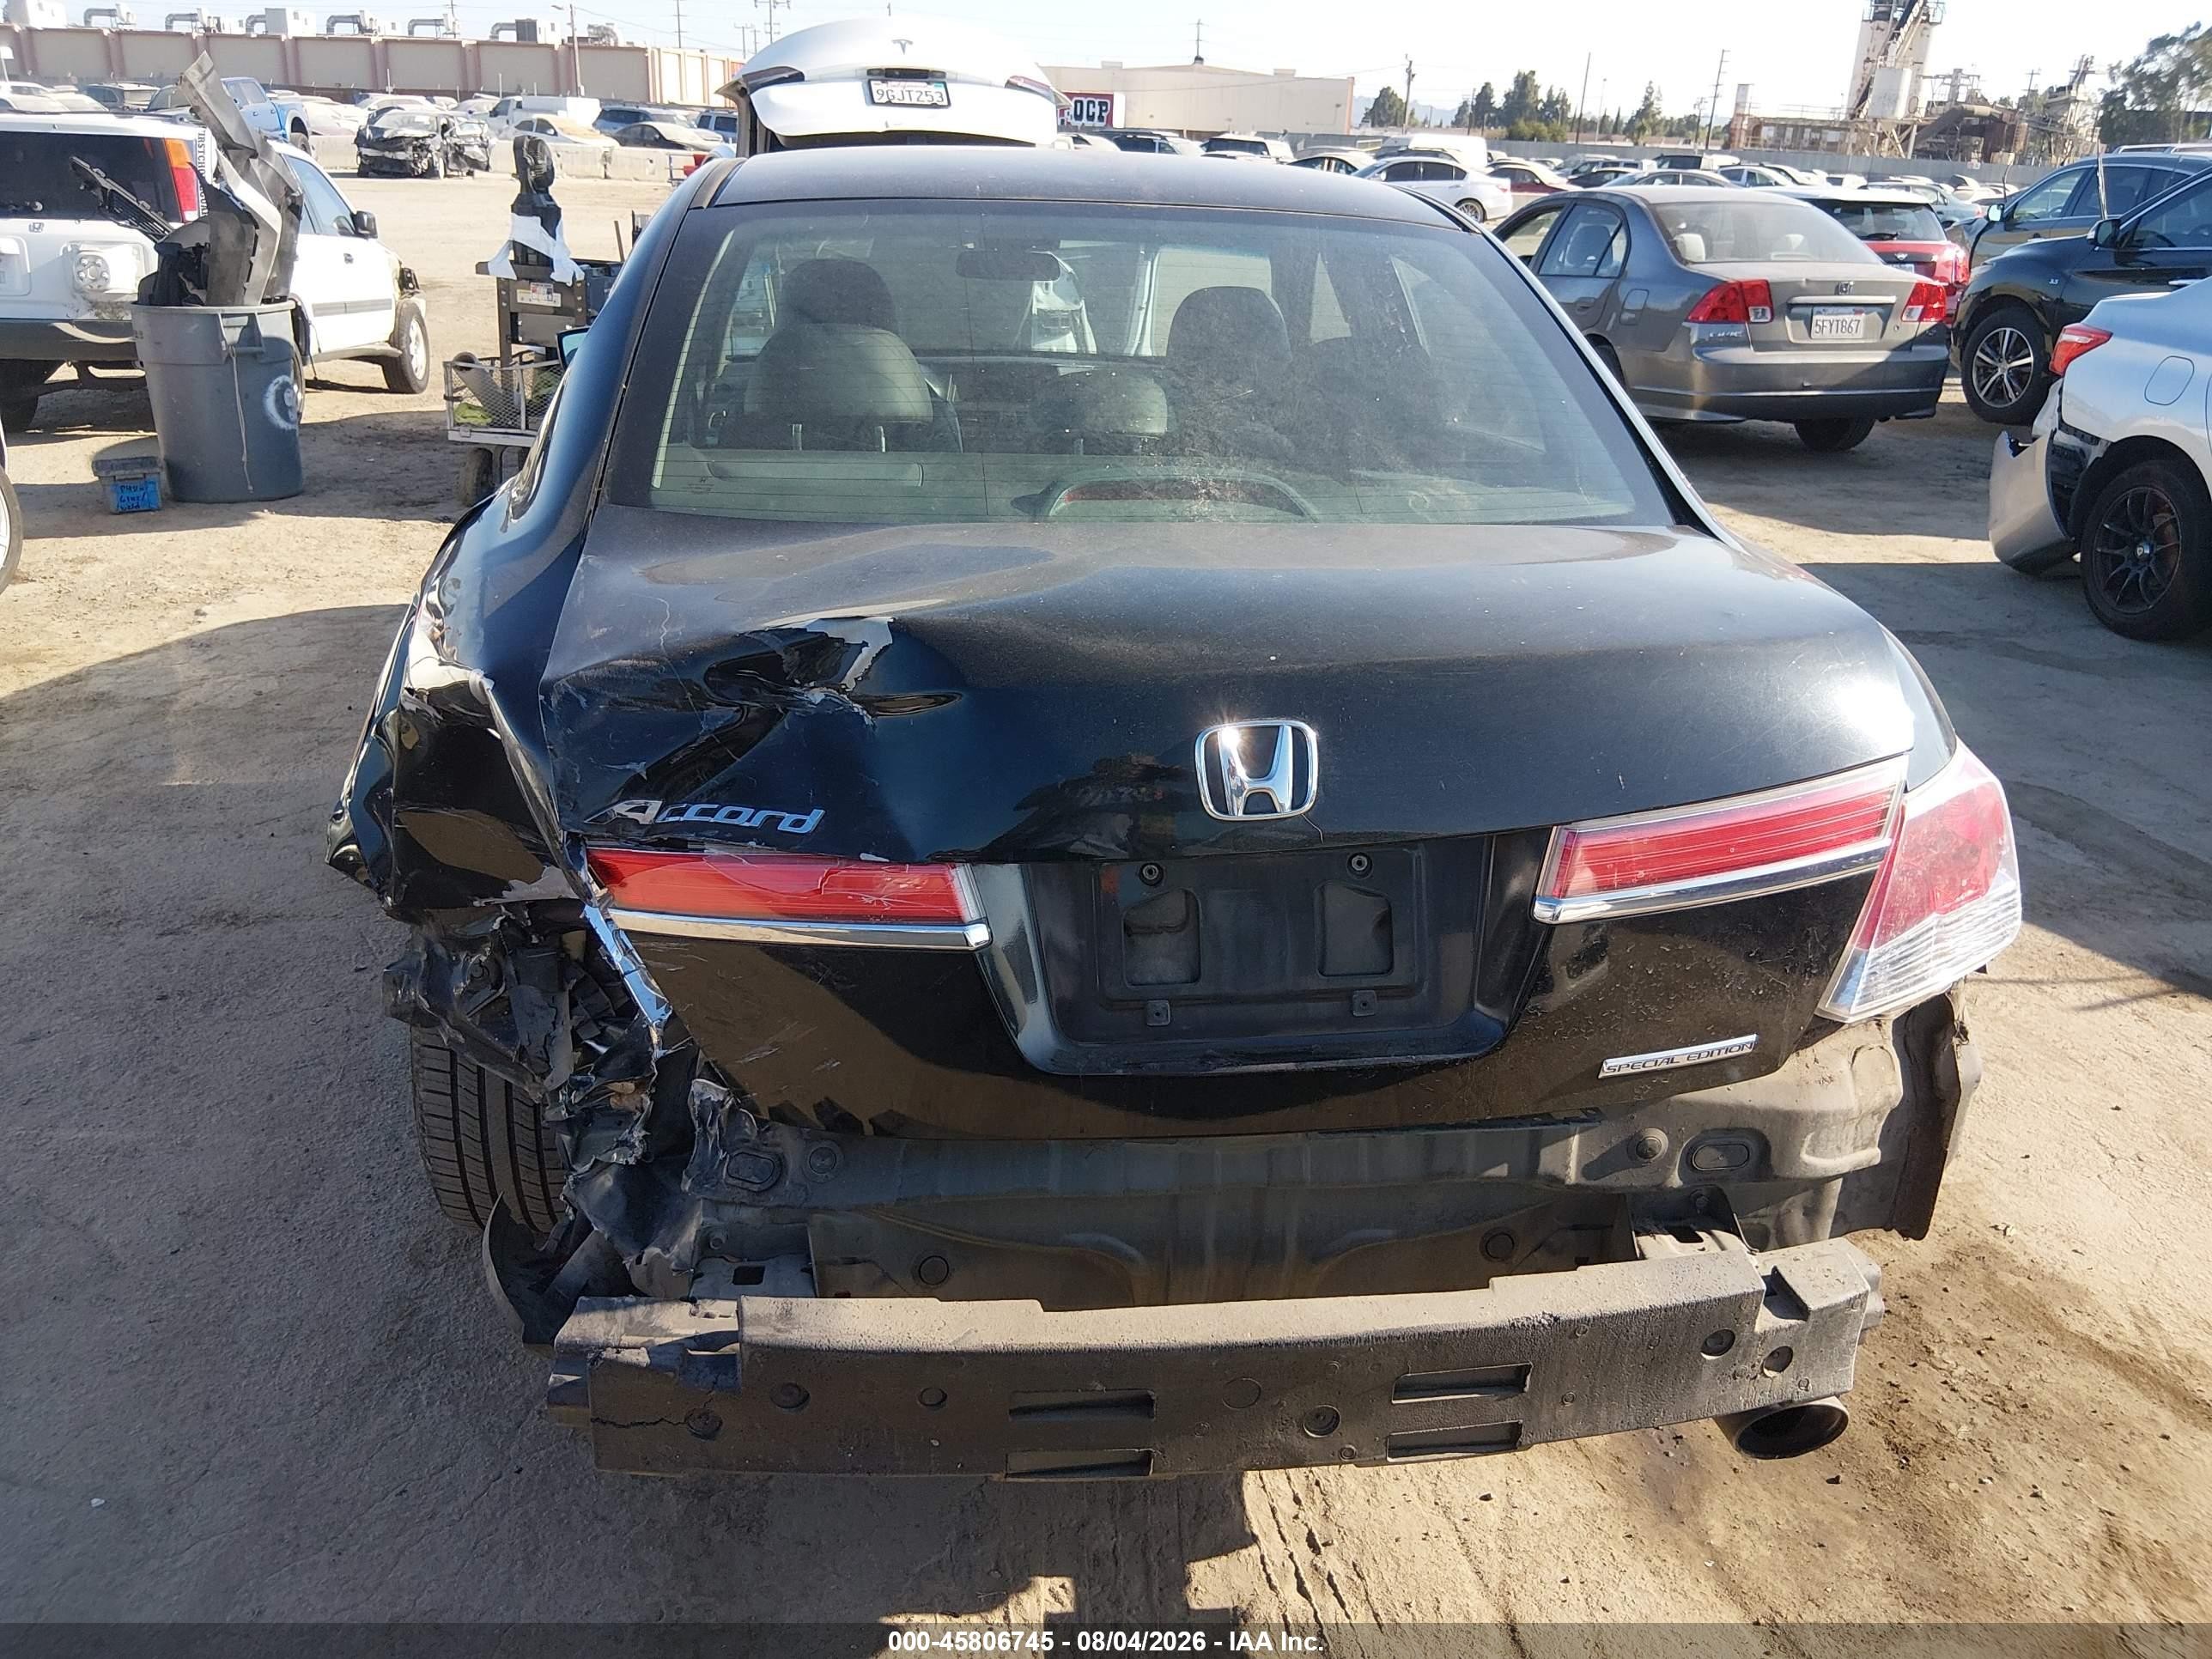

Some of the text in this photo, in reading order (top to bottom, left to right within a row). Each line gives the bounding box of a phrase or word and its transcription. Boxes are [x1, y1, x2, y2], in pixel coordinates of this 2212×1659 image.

[876, 88, 944, 102] 9GJT253
[1067, 99, 1109, 124] OCP
[1814, 319, 1861, 334] 5FYT867
[584, 799, 825, 834] Accord
[1606, 1042, 1754, 1073] SPECIAL EDITION
